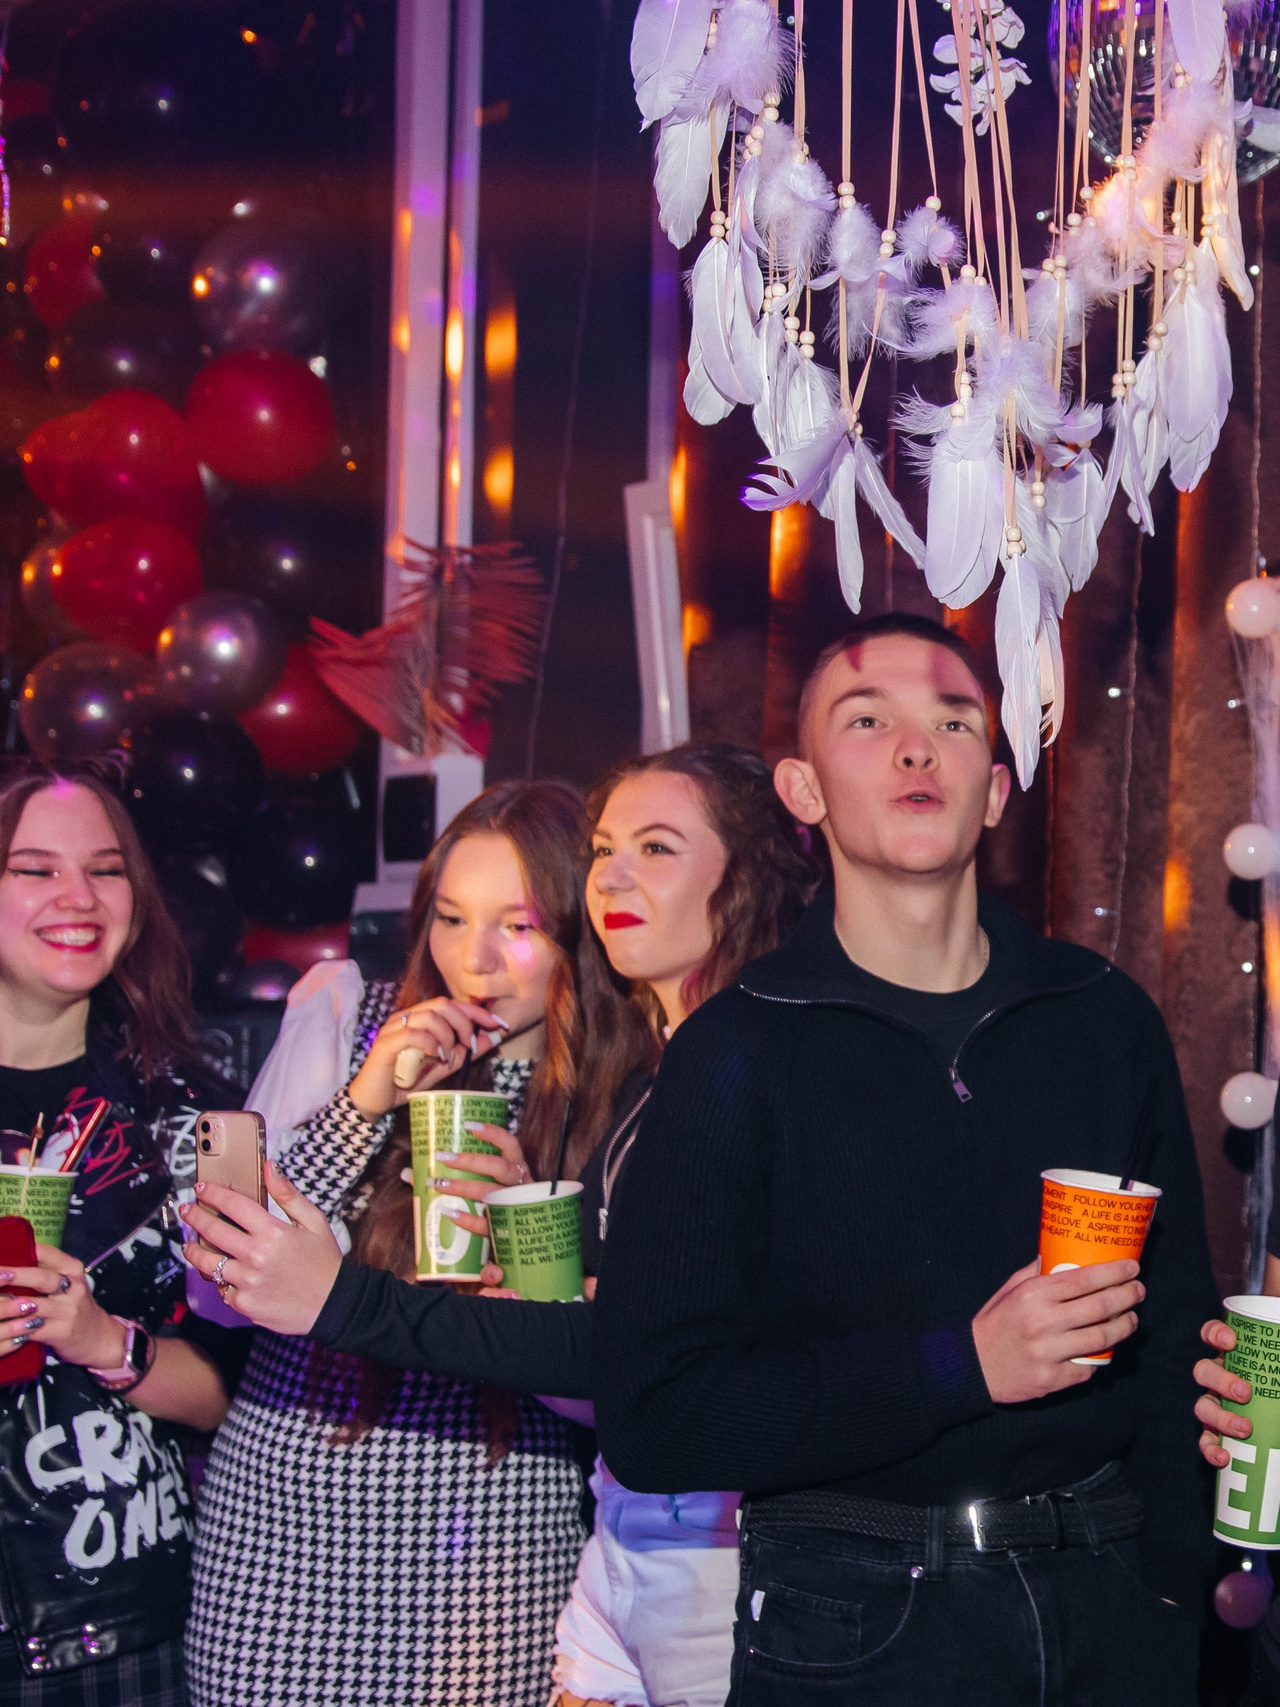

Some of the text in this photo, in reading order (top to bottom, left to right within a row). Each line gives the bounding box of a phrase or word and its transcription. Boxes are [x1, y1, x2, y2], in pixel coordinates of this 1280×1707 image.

[549, 1201, 562, 1211] TO
[1073, 1194, 1117, 1208] FOLLOW
[1119, 1201, 1143, 1211] YOUR
[1091, 1210, 1112, 1221] LIFE
[1114, 1213, 1122, 1222] IS
[1124, 1214, 1130, 1222] A
[1050, 1213, 1057, 1222] IS
[1057, 1216, 1081, 1228] LOVE
[1087, 1221, 1121, 1234] ASPIRE
[1123, 1225, 1134, 1234] TO
[516, 1224, 555, 1236] FOLLOW
[1074, 1232, 1091, 1242] ALL
[1094, 1235, 1110, 1244] WE
[1111, 1236, 1133, 1246] NEED
[553, 1241, 565, 1251] TO
[520, 1256, 536, 1265] ALL
[538, 1254, 552, 1264] WE
[1232, 1317, 1258, 1333] ASPIRE
[1259, 1325, 1274, 1337] TO
[1244, 1333, 1258, 1346] WE
[1233, 1355, 1249, 1367] LIFE
[1249, 1360, 1258, 1371] IS
[1259, 1363, 1266, 1373] A
[1254, 1373, 1268, 1385] TO
